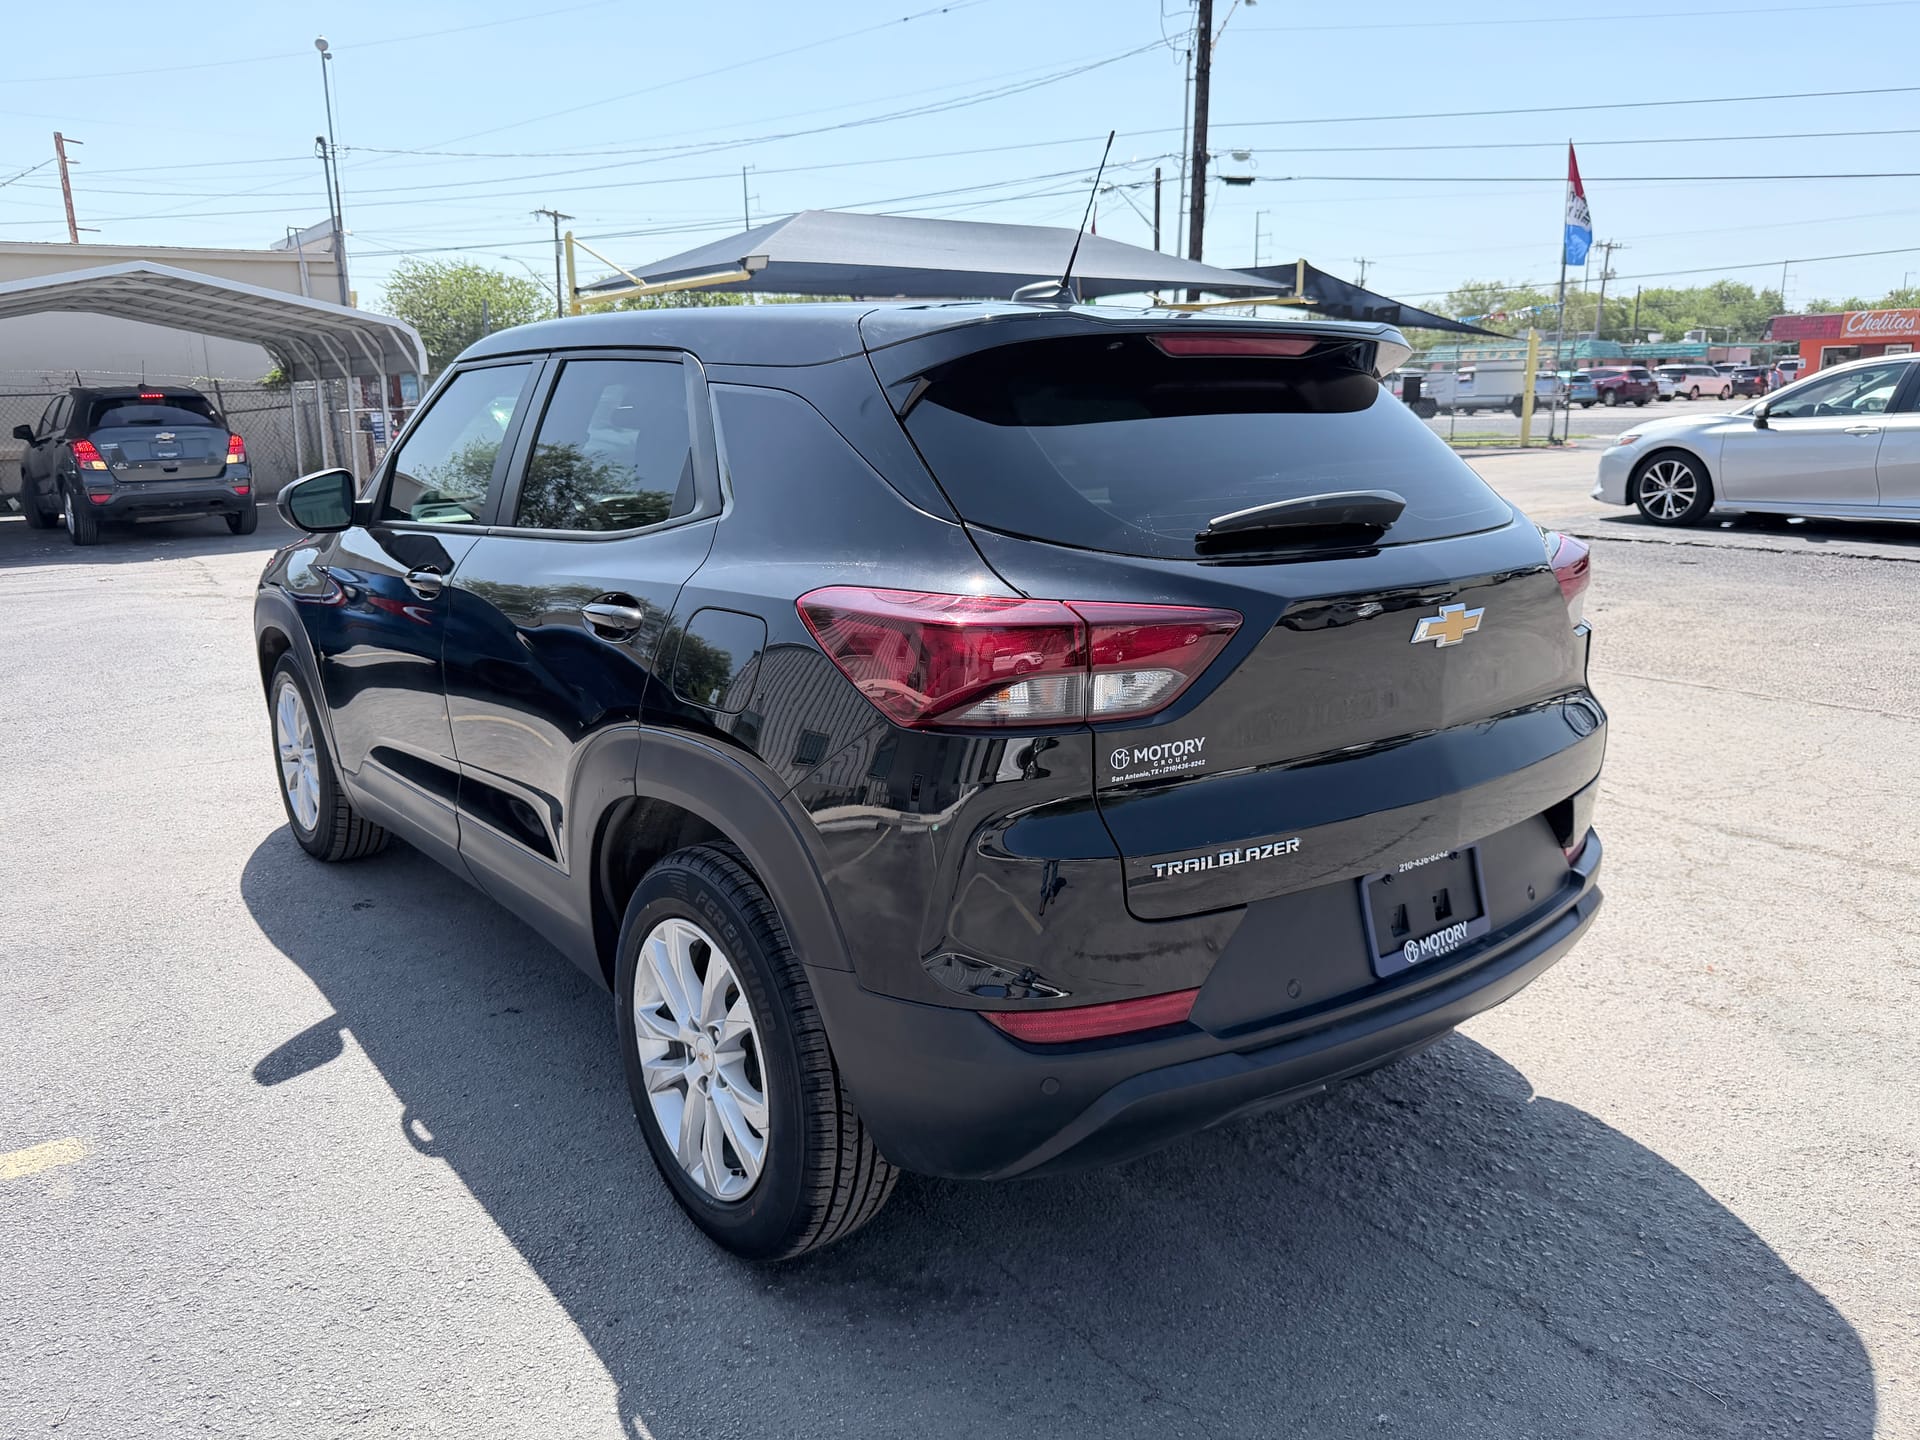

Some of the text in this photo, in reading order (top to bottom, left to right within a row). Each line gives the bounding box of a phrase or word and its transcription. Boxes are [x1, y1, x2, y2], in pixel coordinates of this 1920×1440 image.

[1846, 311, 1916, 332] Chelitas
[1133, 737, 1206, 764] MOTORY
[1153, 755, 1188, 767] GROUP
[1111, 775, 1124, 783] San
[1125, 770, 1151, 780] Antonio,
[1151, 837, 1302, 878] TRAILBLAZER
[1419, 921, 1468, 955] MOTORY
[1434, 942, 1460, 957] GROUP
[694, 888, 777, 1032] FERENTINO
